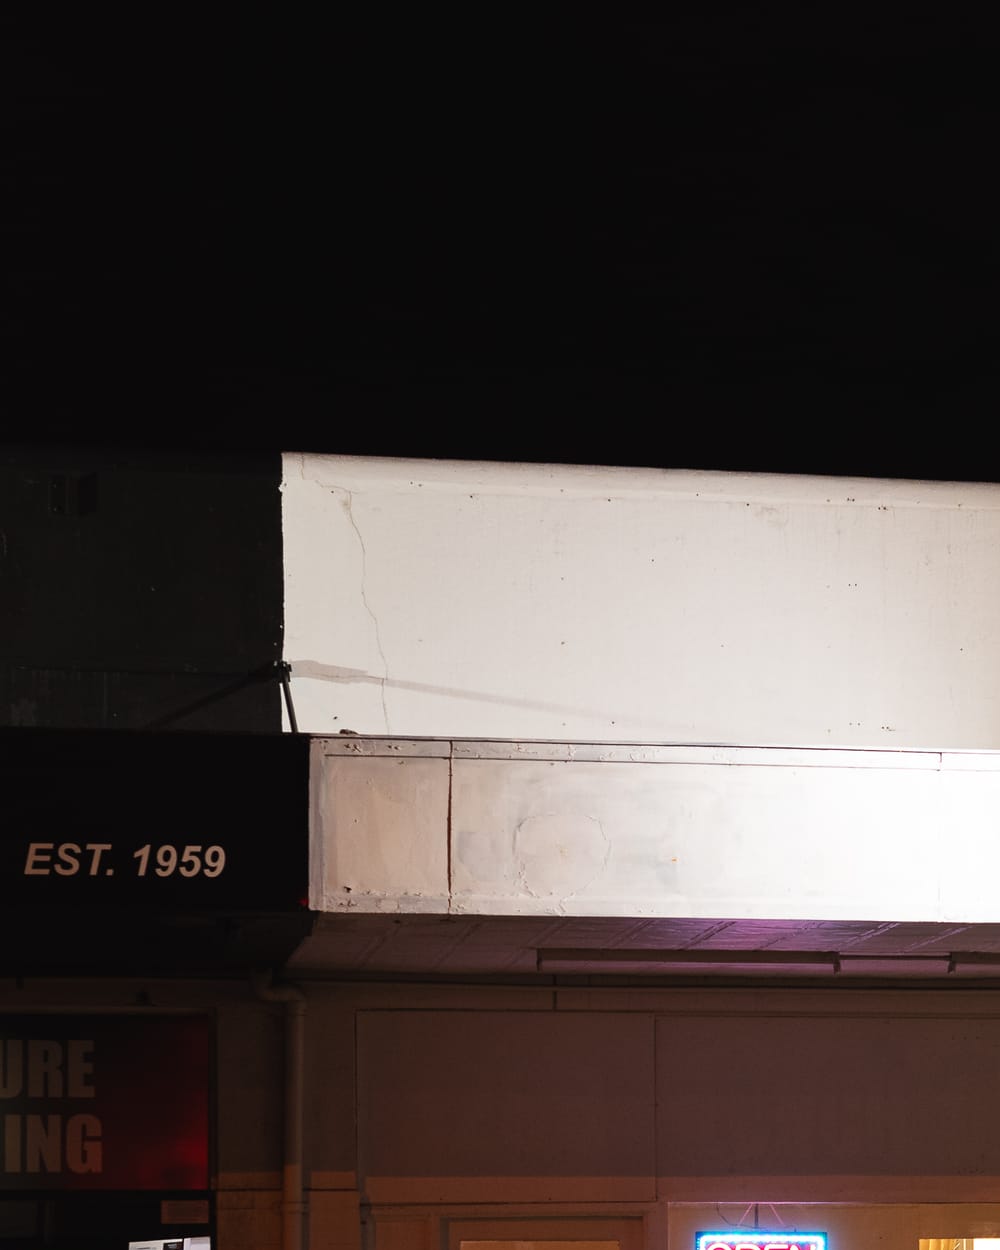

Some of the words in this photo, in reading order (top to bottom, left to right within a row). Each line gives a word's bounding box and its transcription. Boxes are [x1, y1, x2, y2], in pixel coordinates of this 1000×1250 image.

[24, 842, 115, 876] EST.
[133, 844, 226, 878] 1959
[4, 1112, 104, 1174] ING
